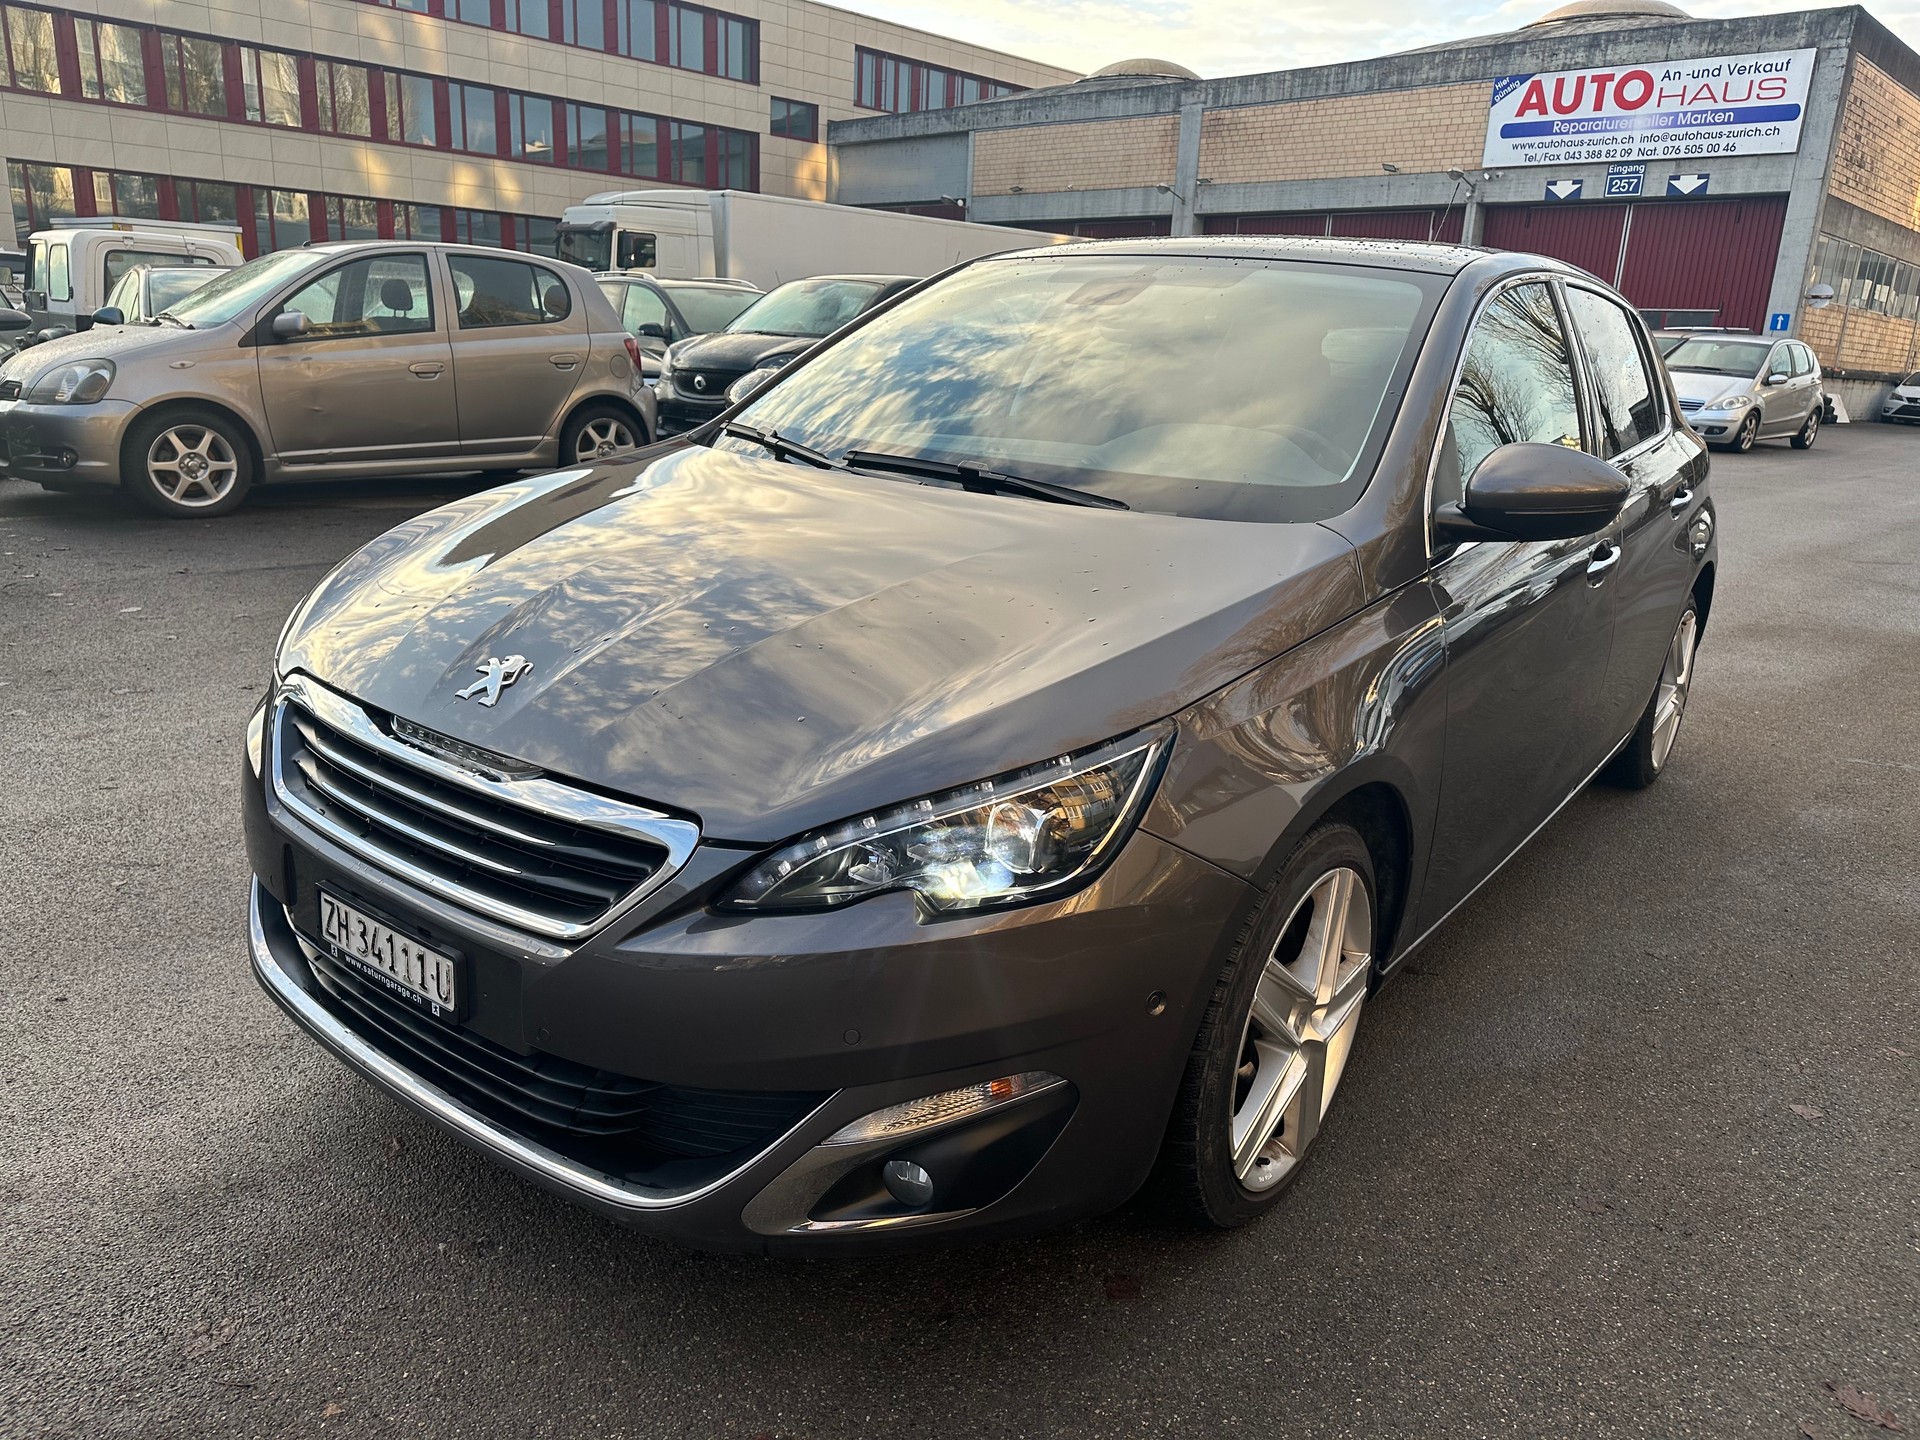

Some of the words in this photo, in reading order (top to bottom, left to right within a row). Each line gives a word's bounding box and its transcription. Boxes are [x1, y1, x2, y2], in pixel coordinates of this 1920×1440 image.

[1661, 69, 1681, 82] An
[1727, 58, 1792, 76] Verkauf
[1494, 80, 1521, 102] günstig
[1495, 77, 1510, 90] Hier
[1514, 69, 1655, 117] AUTO
[1656, 77, 1788, 108] HAUS
[1644, 114, 1674, 128] aller
[1677, 110, 1734, 125] Marken
[1512, 135, 1634, 150] www.autohaus-zurich.ch
[1640, 126, 1780, 143] info@autohaus-zurich.ch
[1524, 152, 1561, 163] Tel./Fax
[1564, 151, 1581, 160] 043
[1585, 150, 1602, 159] 388
[1605, 149, 1617, 159] 82
[1620, 148, 1632, 158] 09
[1637, 147, 1659, 157] Nat.
[1662, 145, 1681, 155] 076
[1684, 144, 1704, 154] 505
[1706, 143, 1720, 153] 00
[1723, 142, 1737, 152] 46
[1609, 164, 1645, 174] Eingang
[1611, 179, 1638, 192] 257
[344, 954, 422, 1004] www.saturngarage.ch
